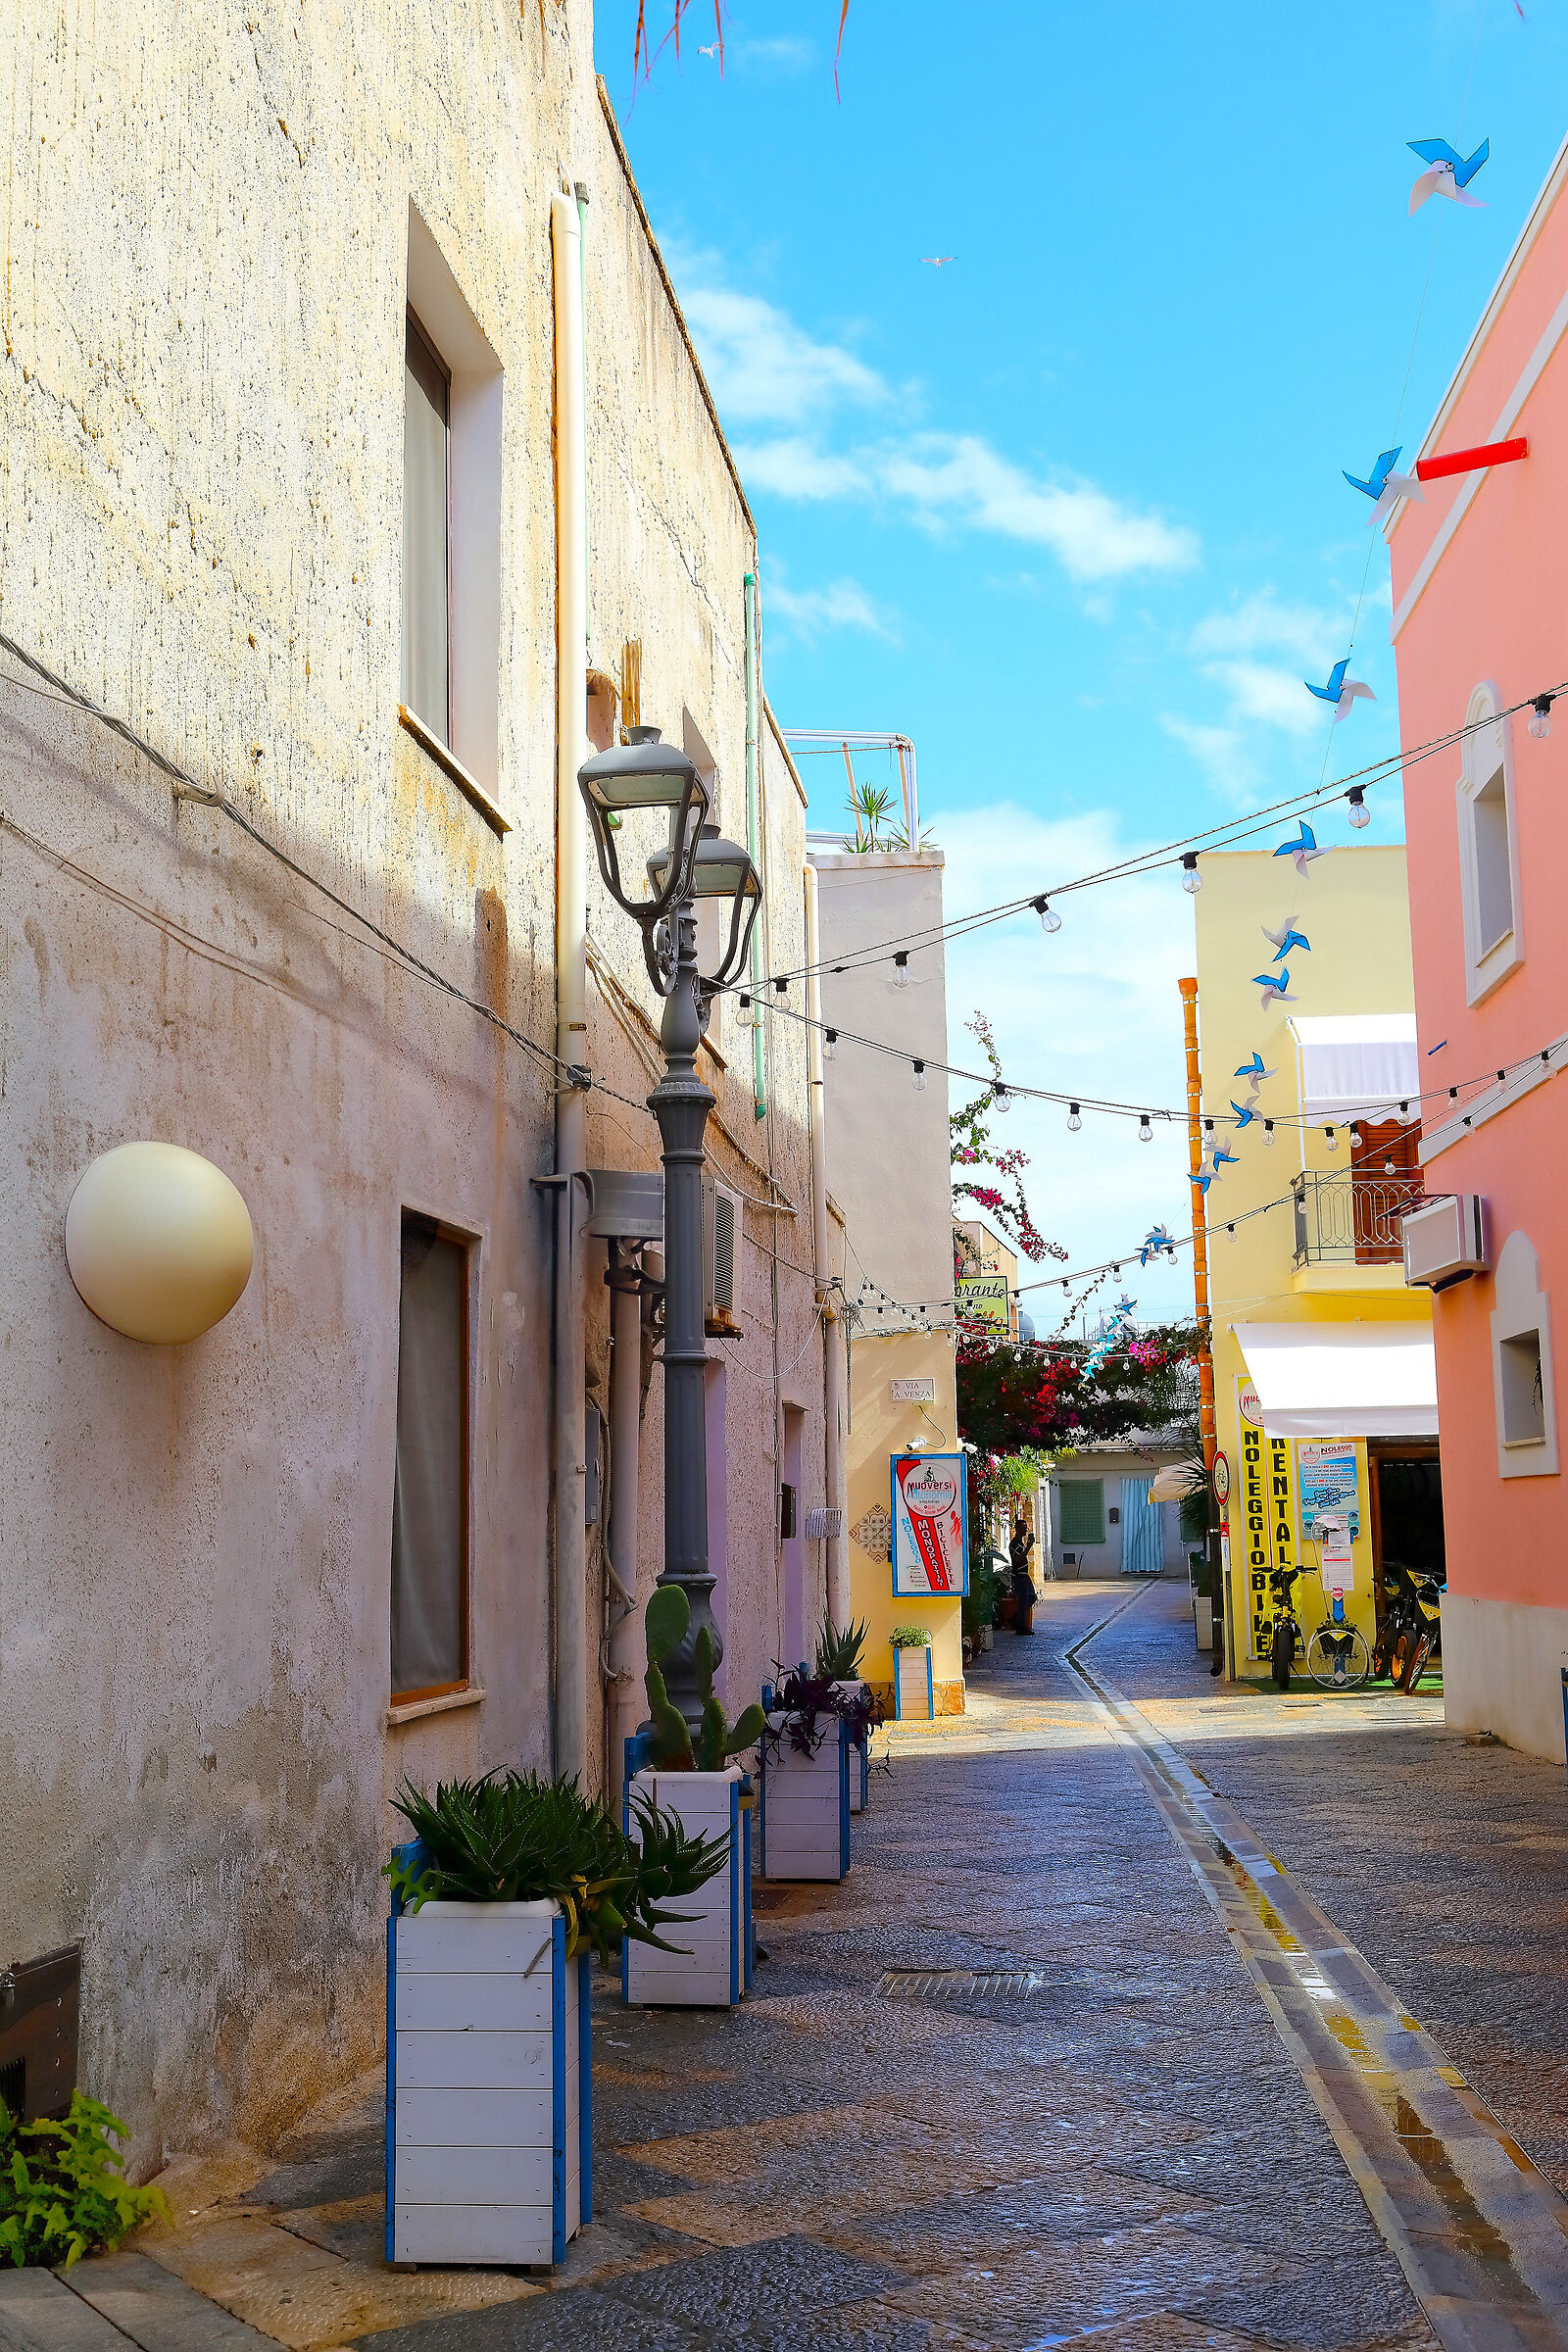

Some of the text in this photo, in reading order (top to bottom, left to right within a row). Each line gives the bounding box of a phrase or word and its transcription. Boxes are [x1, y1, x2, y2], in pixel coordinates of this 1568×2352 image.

[1244, 1430, 1265, 1566] NOLEGGIO
[902, 1517, 921, 1564] NOLEGGIO
[937, 1521, 956, 1585] BICICLETTE
